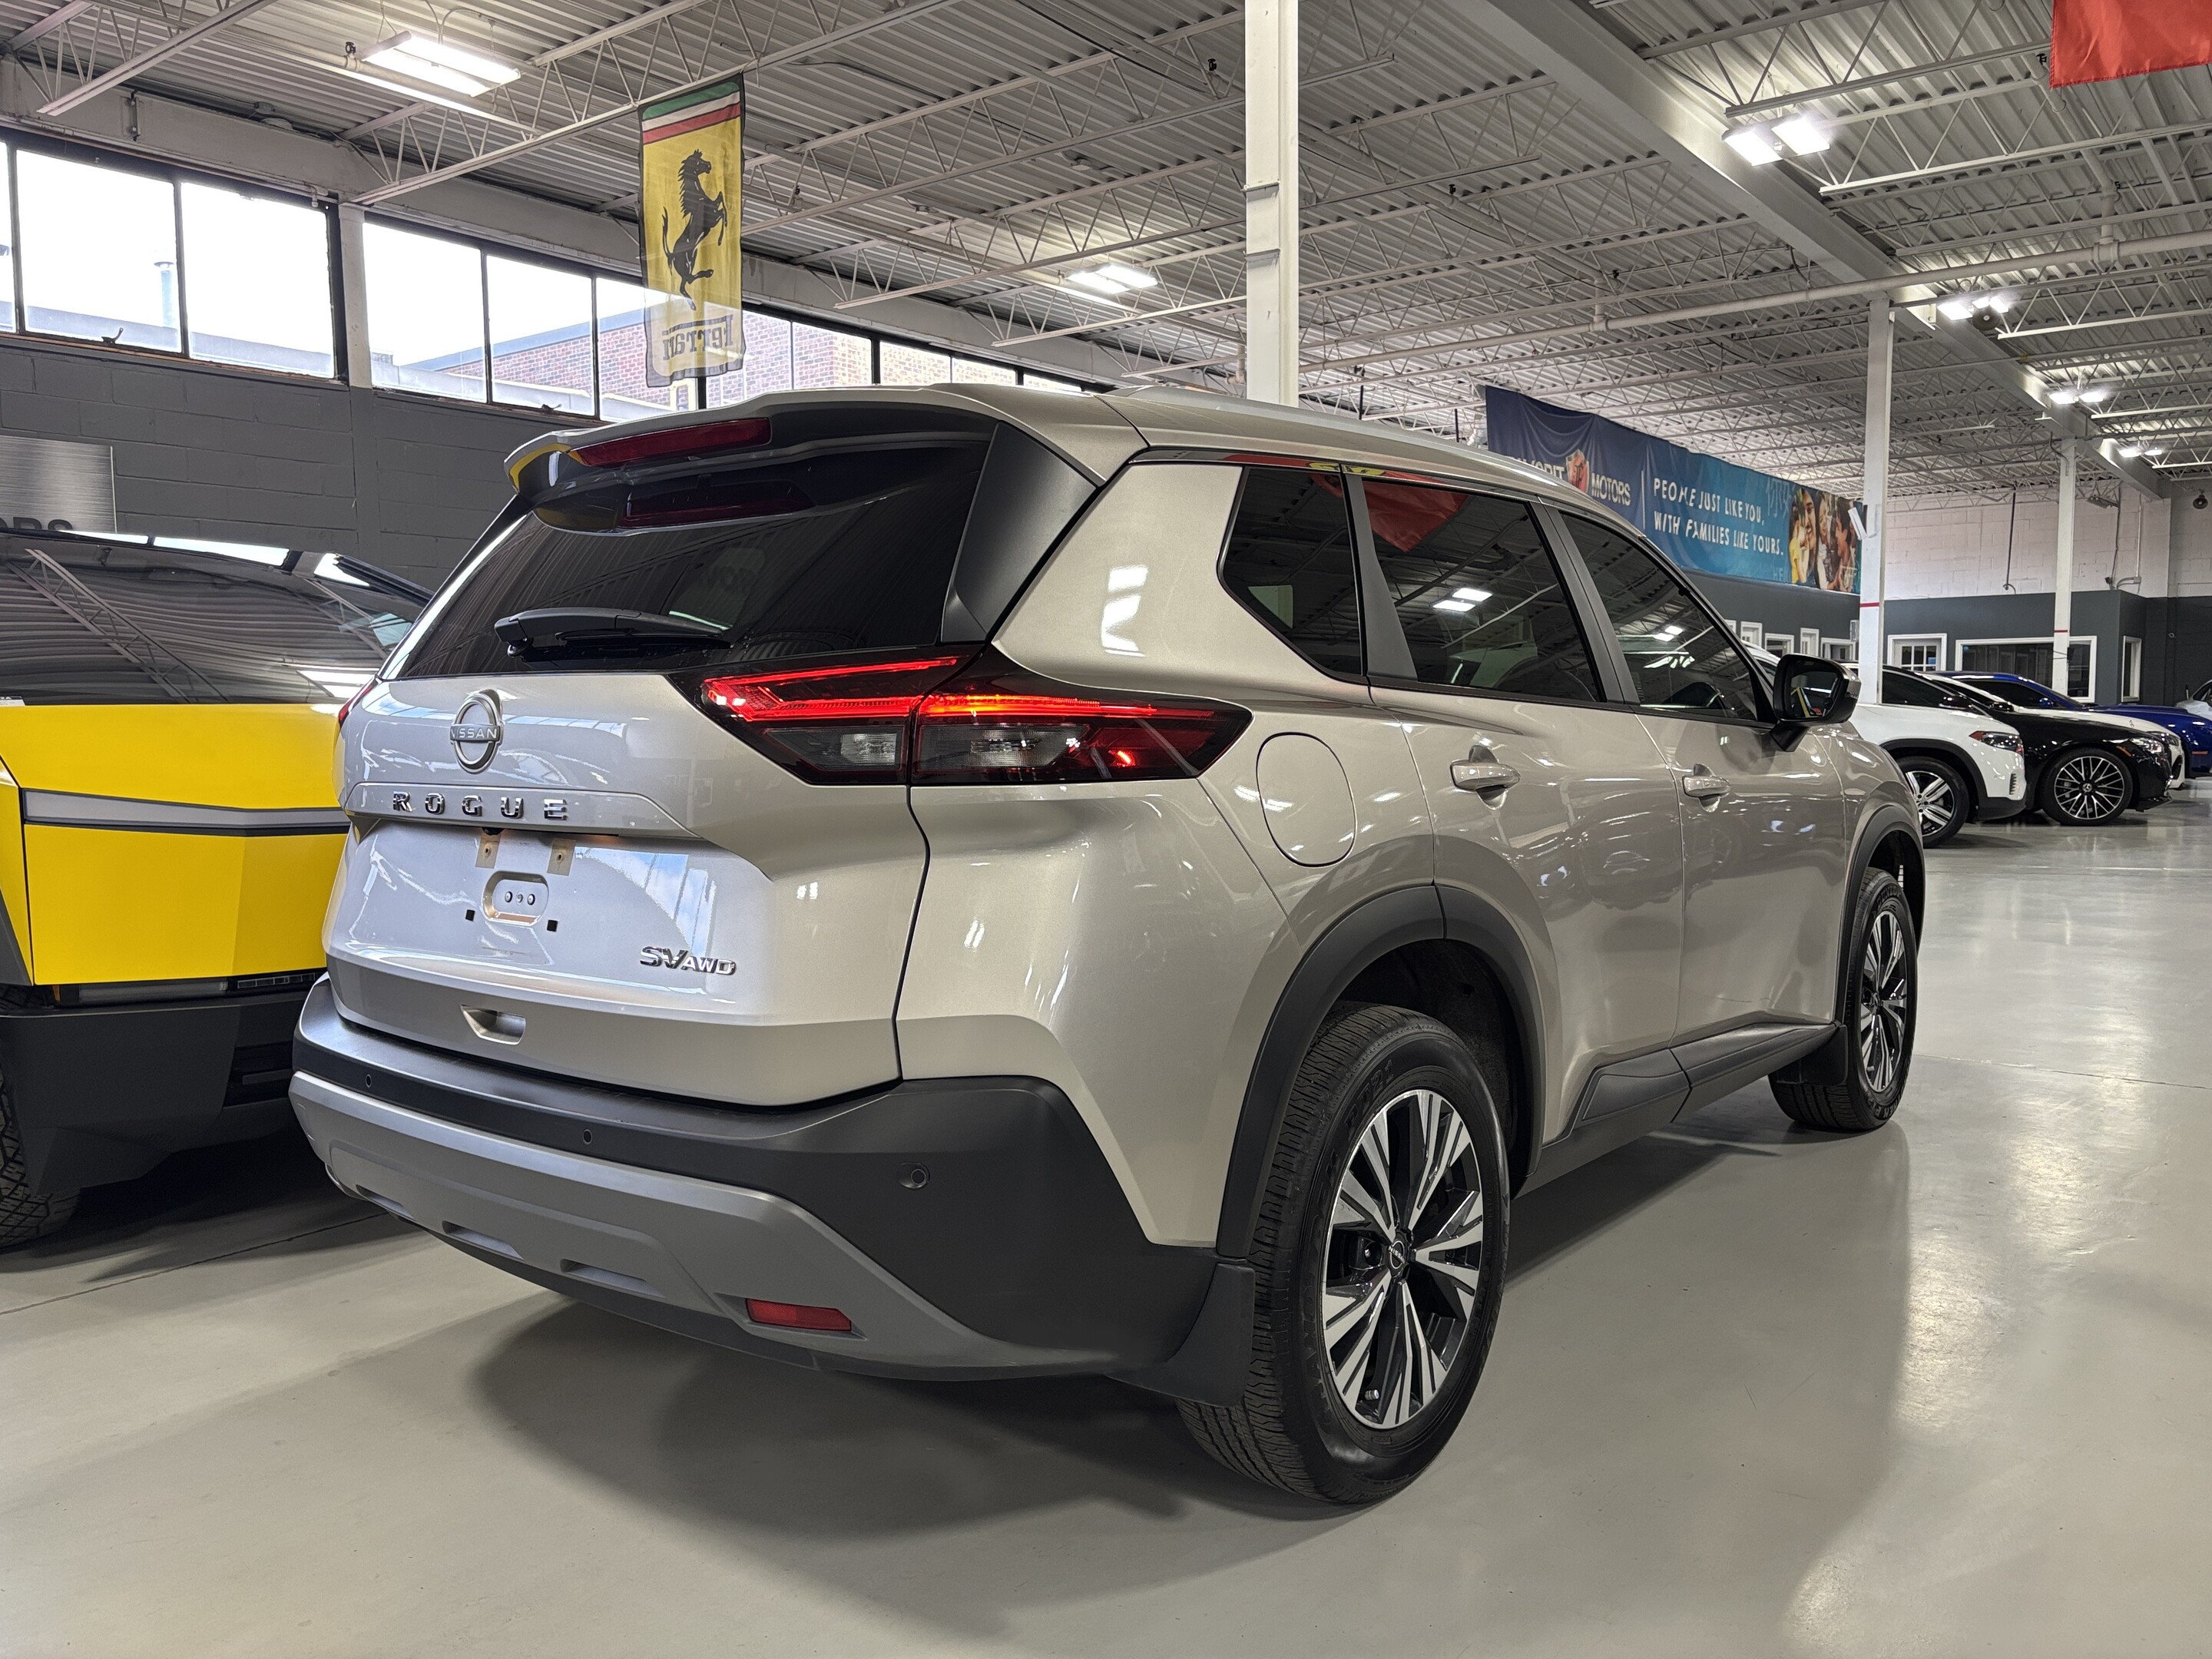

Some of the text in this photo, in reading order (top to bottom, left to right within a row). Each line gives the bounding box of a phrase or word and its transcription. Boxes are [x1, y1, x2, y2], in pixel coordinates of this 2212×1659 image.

[1591, 472, 1631, 506] MOTORS
[1698, 492, 1720, 513] JUST
[1724, 498, 1743, 518] LIKE
[1745, 502, 1765, 525] YOU,
[1654, 511, 1784, 556] WITH FAMILIES LIKE YOURS.
[451, 727, 497, 739] NISSAN
[392, 790, 568, 820] ROGUE
[640, 946, 737, 975] SV AWD
